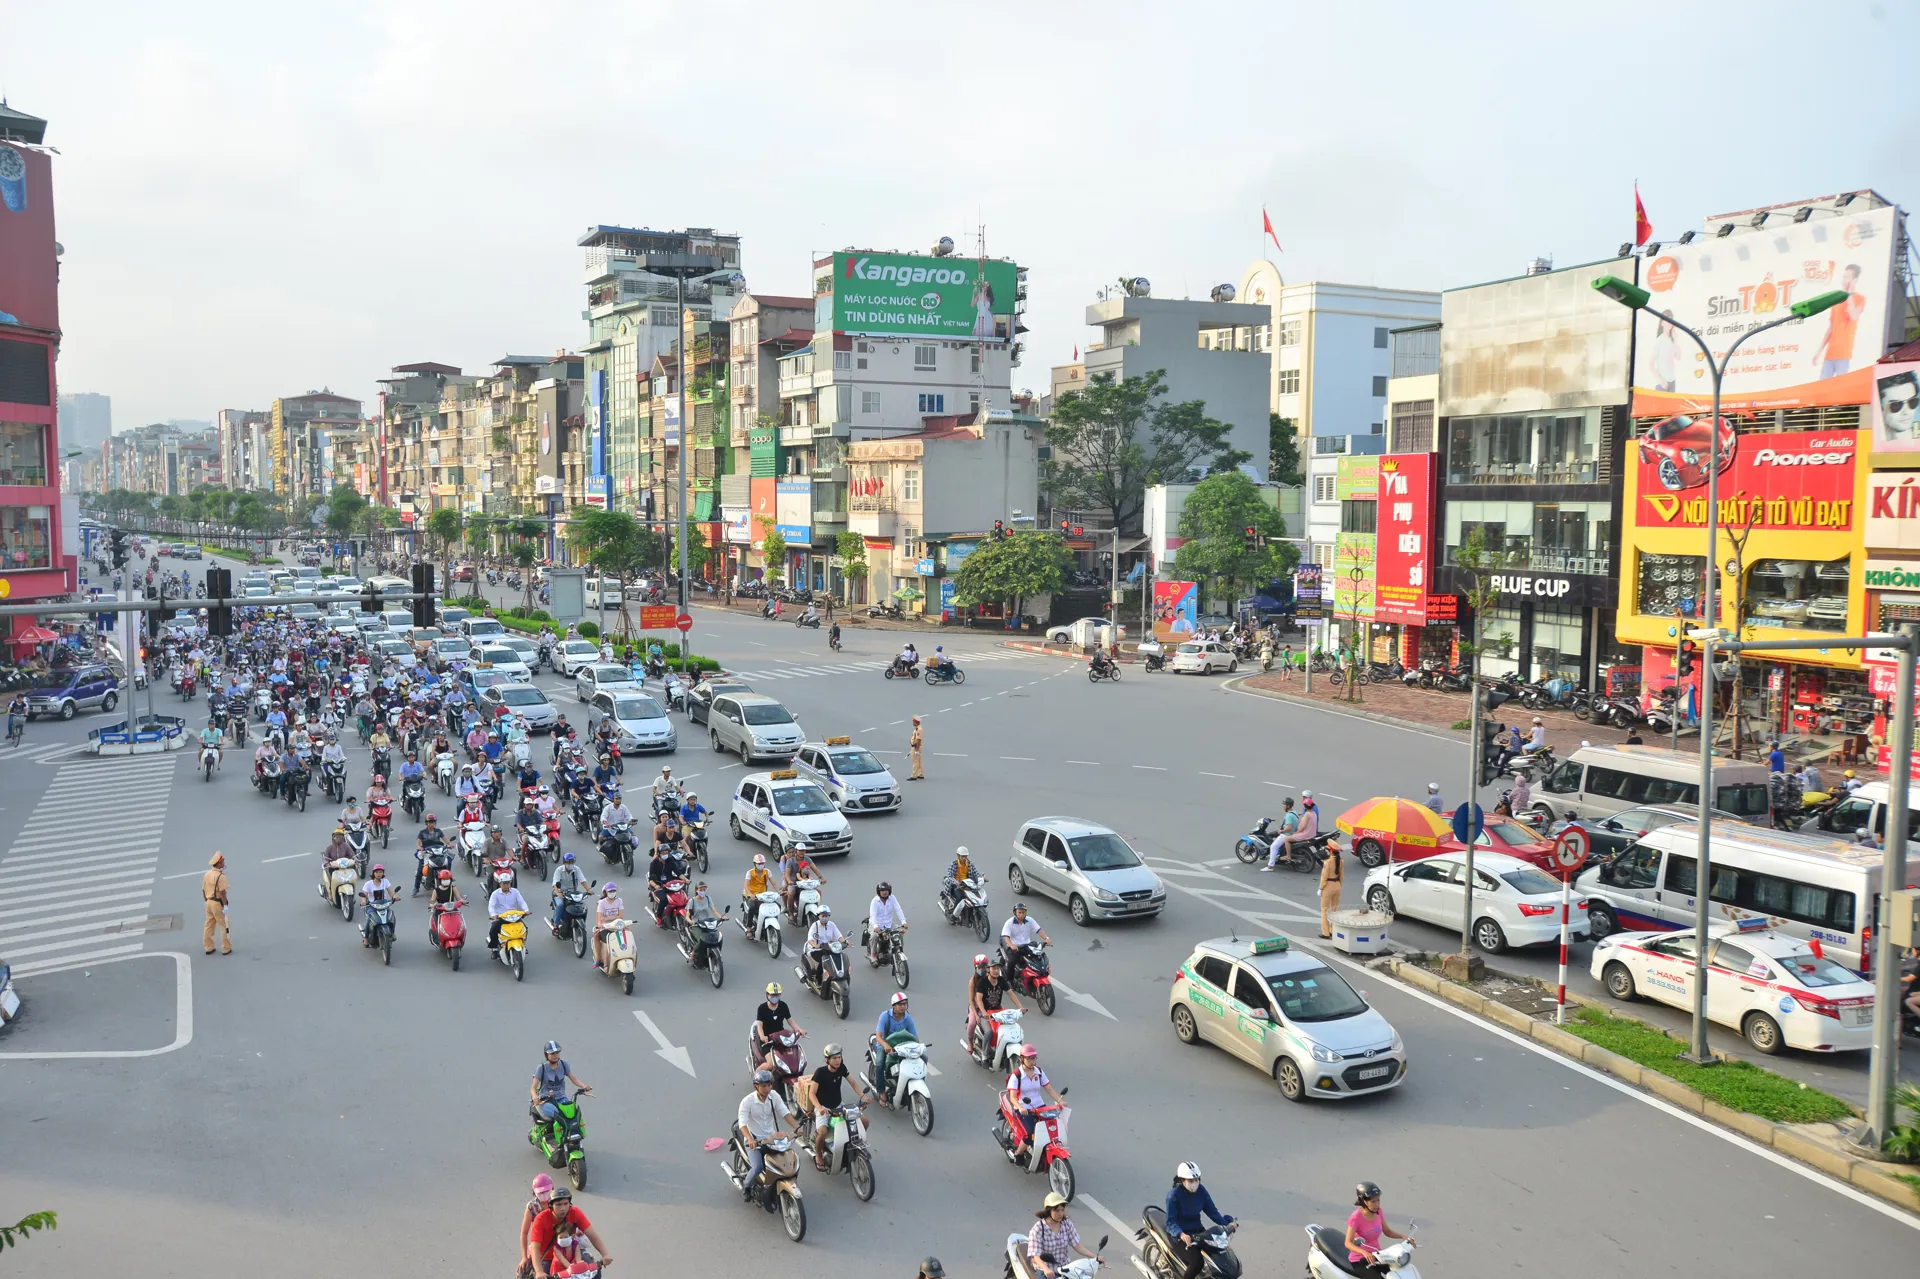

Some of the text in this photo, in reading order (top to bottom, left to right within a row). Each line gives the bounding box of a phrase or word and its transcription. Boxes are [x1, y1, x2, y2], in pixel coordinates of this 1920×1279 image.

[844, 257, 966, 287] Kangaroo
[844, 294, 865, 305] MÁY
[868, 295, 887, 307] LỌC
[889, 294, 917, 307] NƯỚC
[845, 311, 866, 323] TIN
[869, 309, 906, 325] DÙNG
[907, 309, 942, 326] NHẤT
[1809, 437, 1854, 449] Car Audio
[1753, 448, 1854, 467] Pioneer
[1393, 502, 1413, 525] PHỤ
[1766, 495, 1788, 526] TÔ
[1790, 496, 1813, 526] VŨ
[1816, 499, 1852, 529] ĐẠT
[1408, 559, 1424, 586] SỐ
[1491, 575, 1571, 598] BLUE CUP
[1362, 828, 1386, 840] CSGT
